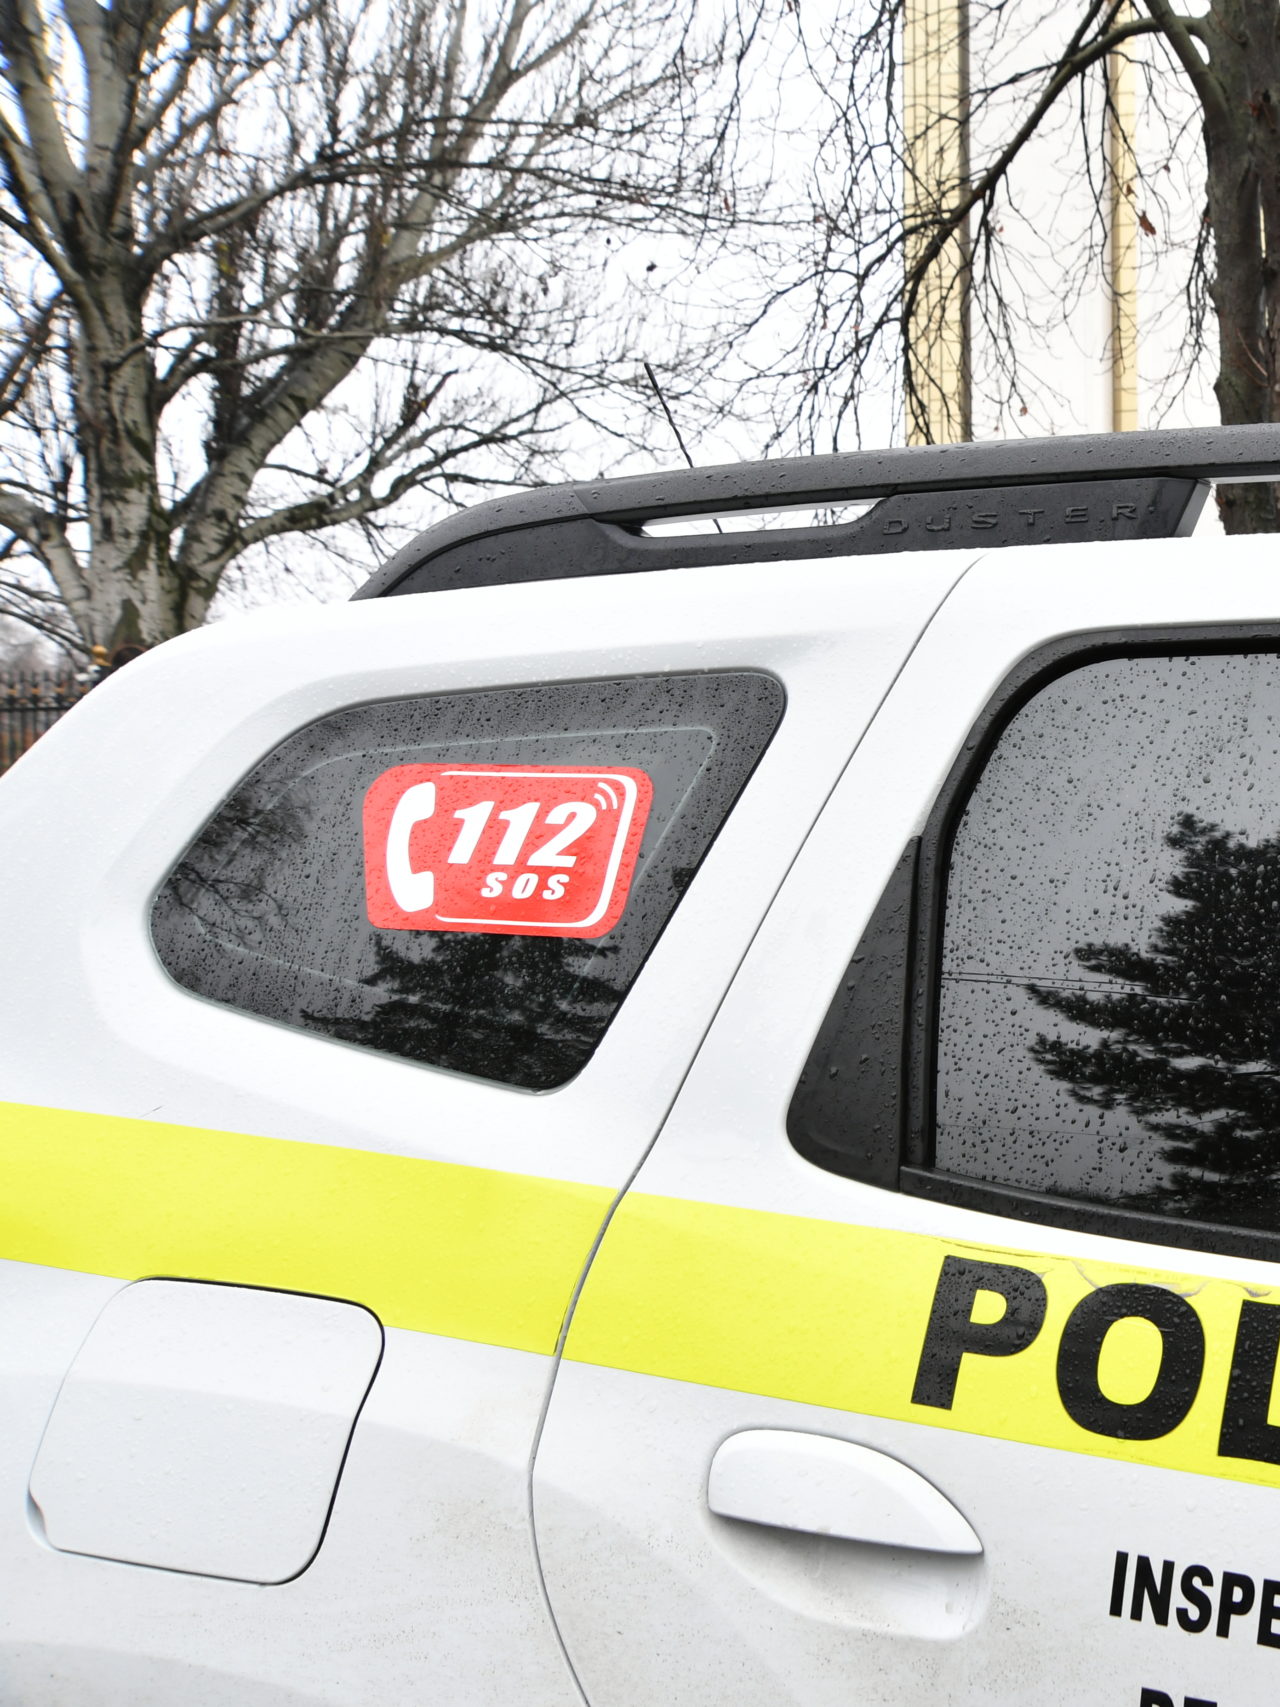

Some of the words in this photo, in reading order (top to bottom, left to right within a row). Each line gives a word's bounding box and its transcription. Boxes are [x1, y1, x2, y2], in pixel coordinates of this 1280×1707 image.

[882, 503, 1138, 536] DUSTER
[447, 800, 598, 868] 112
[480, 871, 570, 900] SOS
